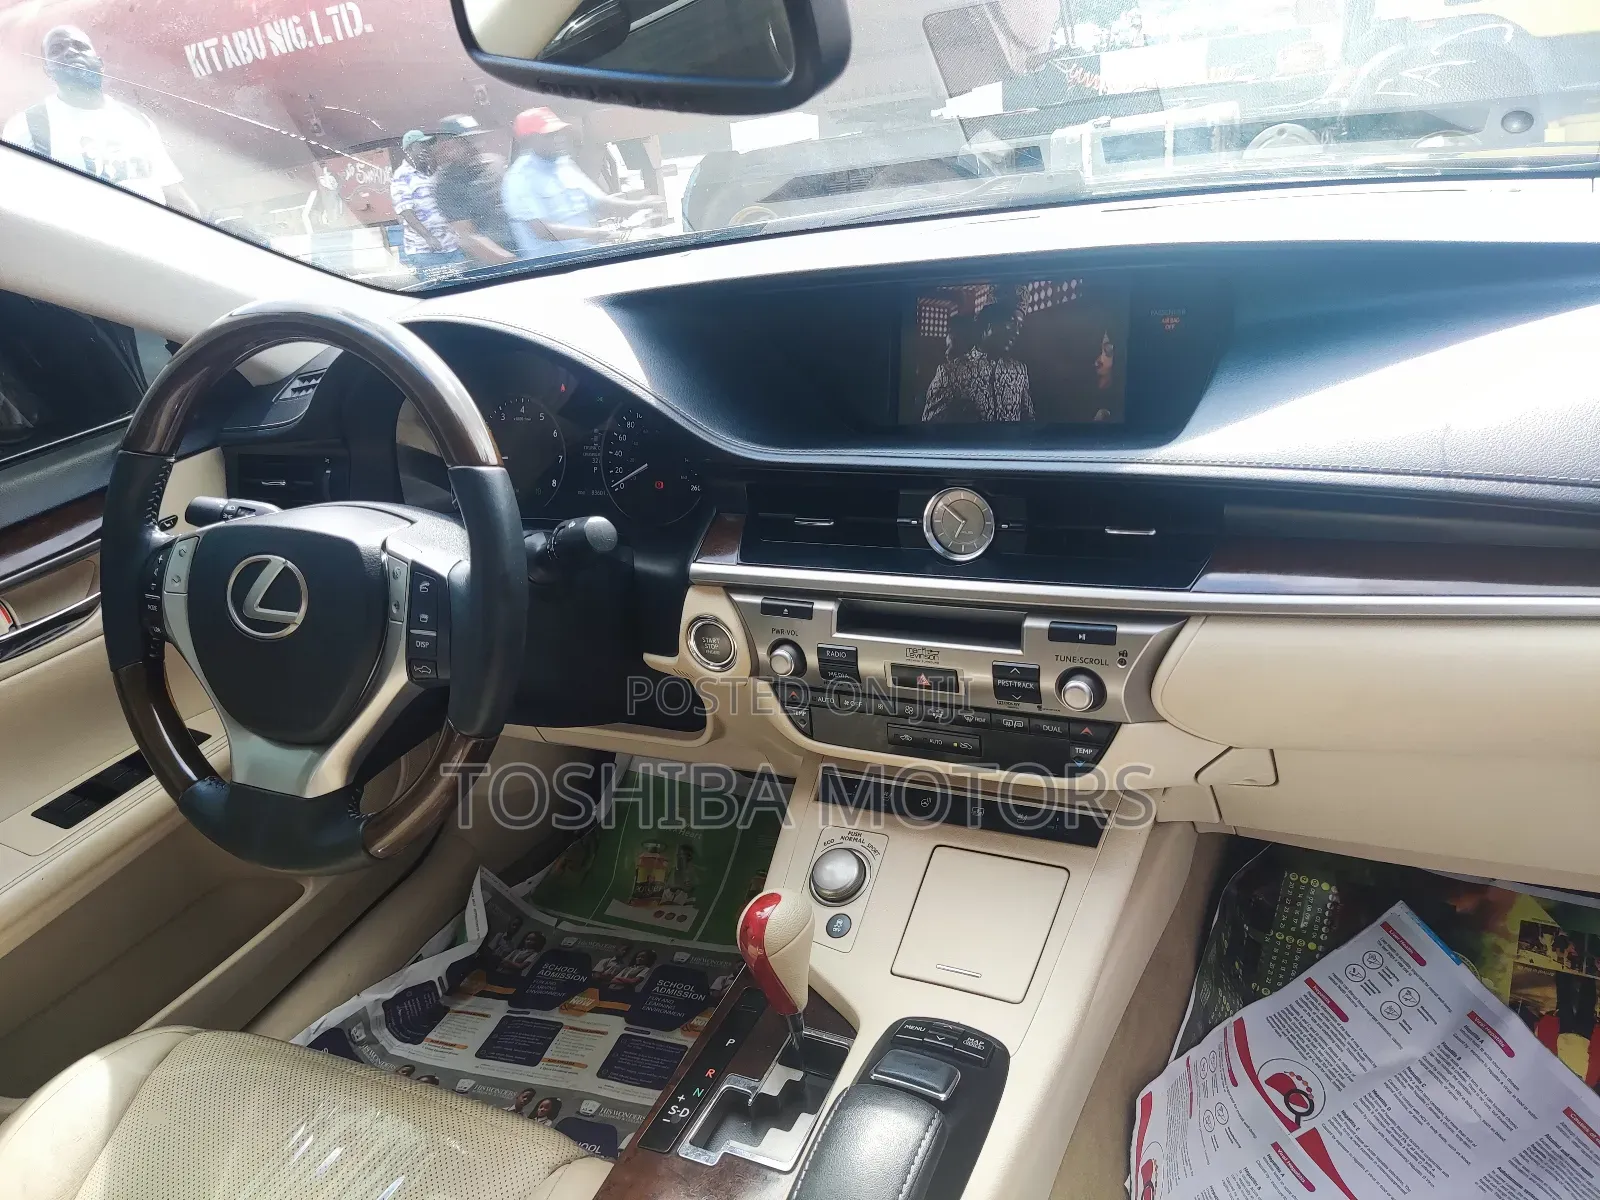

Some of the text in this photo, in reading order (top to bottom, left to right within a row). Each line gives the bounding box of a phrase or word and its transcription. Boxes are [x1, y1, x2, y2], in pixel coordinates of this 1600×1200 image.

[184, 2, 374, 78] KITABU NIG. LTD.
[552, 479, 557, 487] 8
[415, 640, 430, 648] DISP
[826, 650, 847, 659] RADIO
[828, 671, 850, 679] MEDIA
[997, 679, 1034, 689] PRST-TRACK
[1042, 724, 1062, 733] DUAL
[1075, 747, 1093, 755] TEMP
[823, 838, 835, 847] ECO
[840, 836, 866, 845] NORMAL
[867, 842, 880, 856] SPORT
[1388, 929, 1414, 954] Liver Health
[542, 963, 578, 974] SCHOOL
[538, 969, 588, 982] ADMISSION
[657, 980, 696, 992] SCHOOL
[526, 989, 566, 997] ENVIRONMENT
[652, 986, 706, 1001] ADMISSION
[645, 1001, 676, 1010] LEARNING
[642, 1006, 685, 1018] ENVIRONMENT
[904, 1024, 926, 1032] MENU
[1463, 1023, 1481, 1041] Hepatitis
[1473, 1016, 1486, 1029] Viral
[1483, 1026, 1506, 1048] Hepatitis
[725, 1038, 735, 1046] P
[967, 1037, 985, 1045] MAP
[1441, 1040, 1458, 1058] Hepatitis
[705, 1068, 716, 1078] R
[693, 1087, 704, 1097] N
[1370, 1088, 1389, 1107] Hepatitis
[1339, 1109, 1358, 1128] Hepatitis
[1569, 1112, 1590, 1133] Causes
[1264, 1153, 1284, 1173] Hepatitis
[1275, 1148, 1307, 1183] Viral Hepatitis
[1240, 1166, 1262, 1187] Hepatitis
